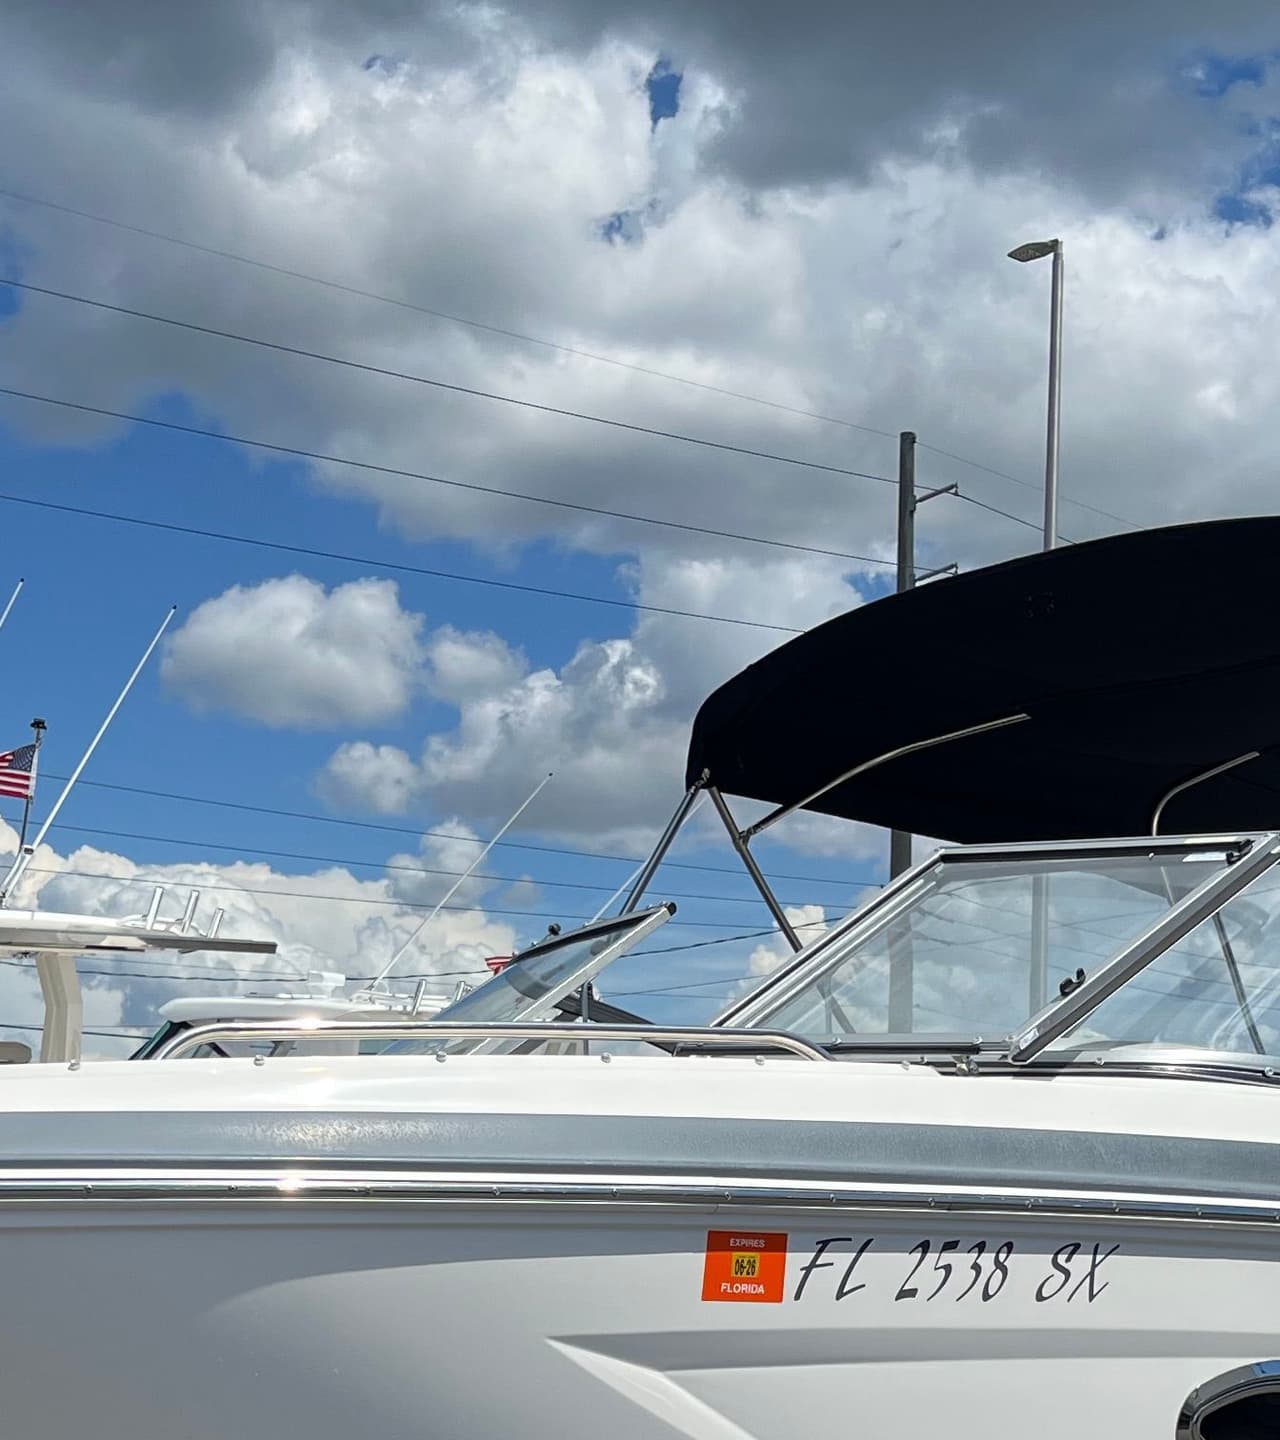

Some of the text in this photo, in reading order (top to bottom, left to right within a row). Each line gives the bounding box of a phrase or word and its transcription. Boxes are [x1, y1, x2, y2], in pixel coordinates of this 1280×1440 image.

[729, 1238, 765, 1249] EXPIRES
[793, 1237, 1121, 1303] FL 2538 SX
[720, 1282, 765, 1295] FLORIDA
